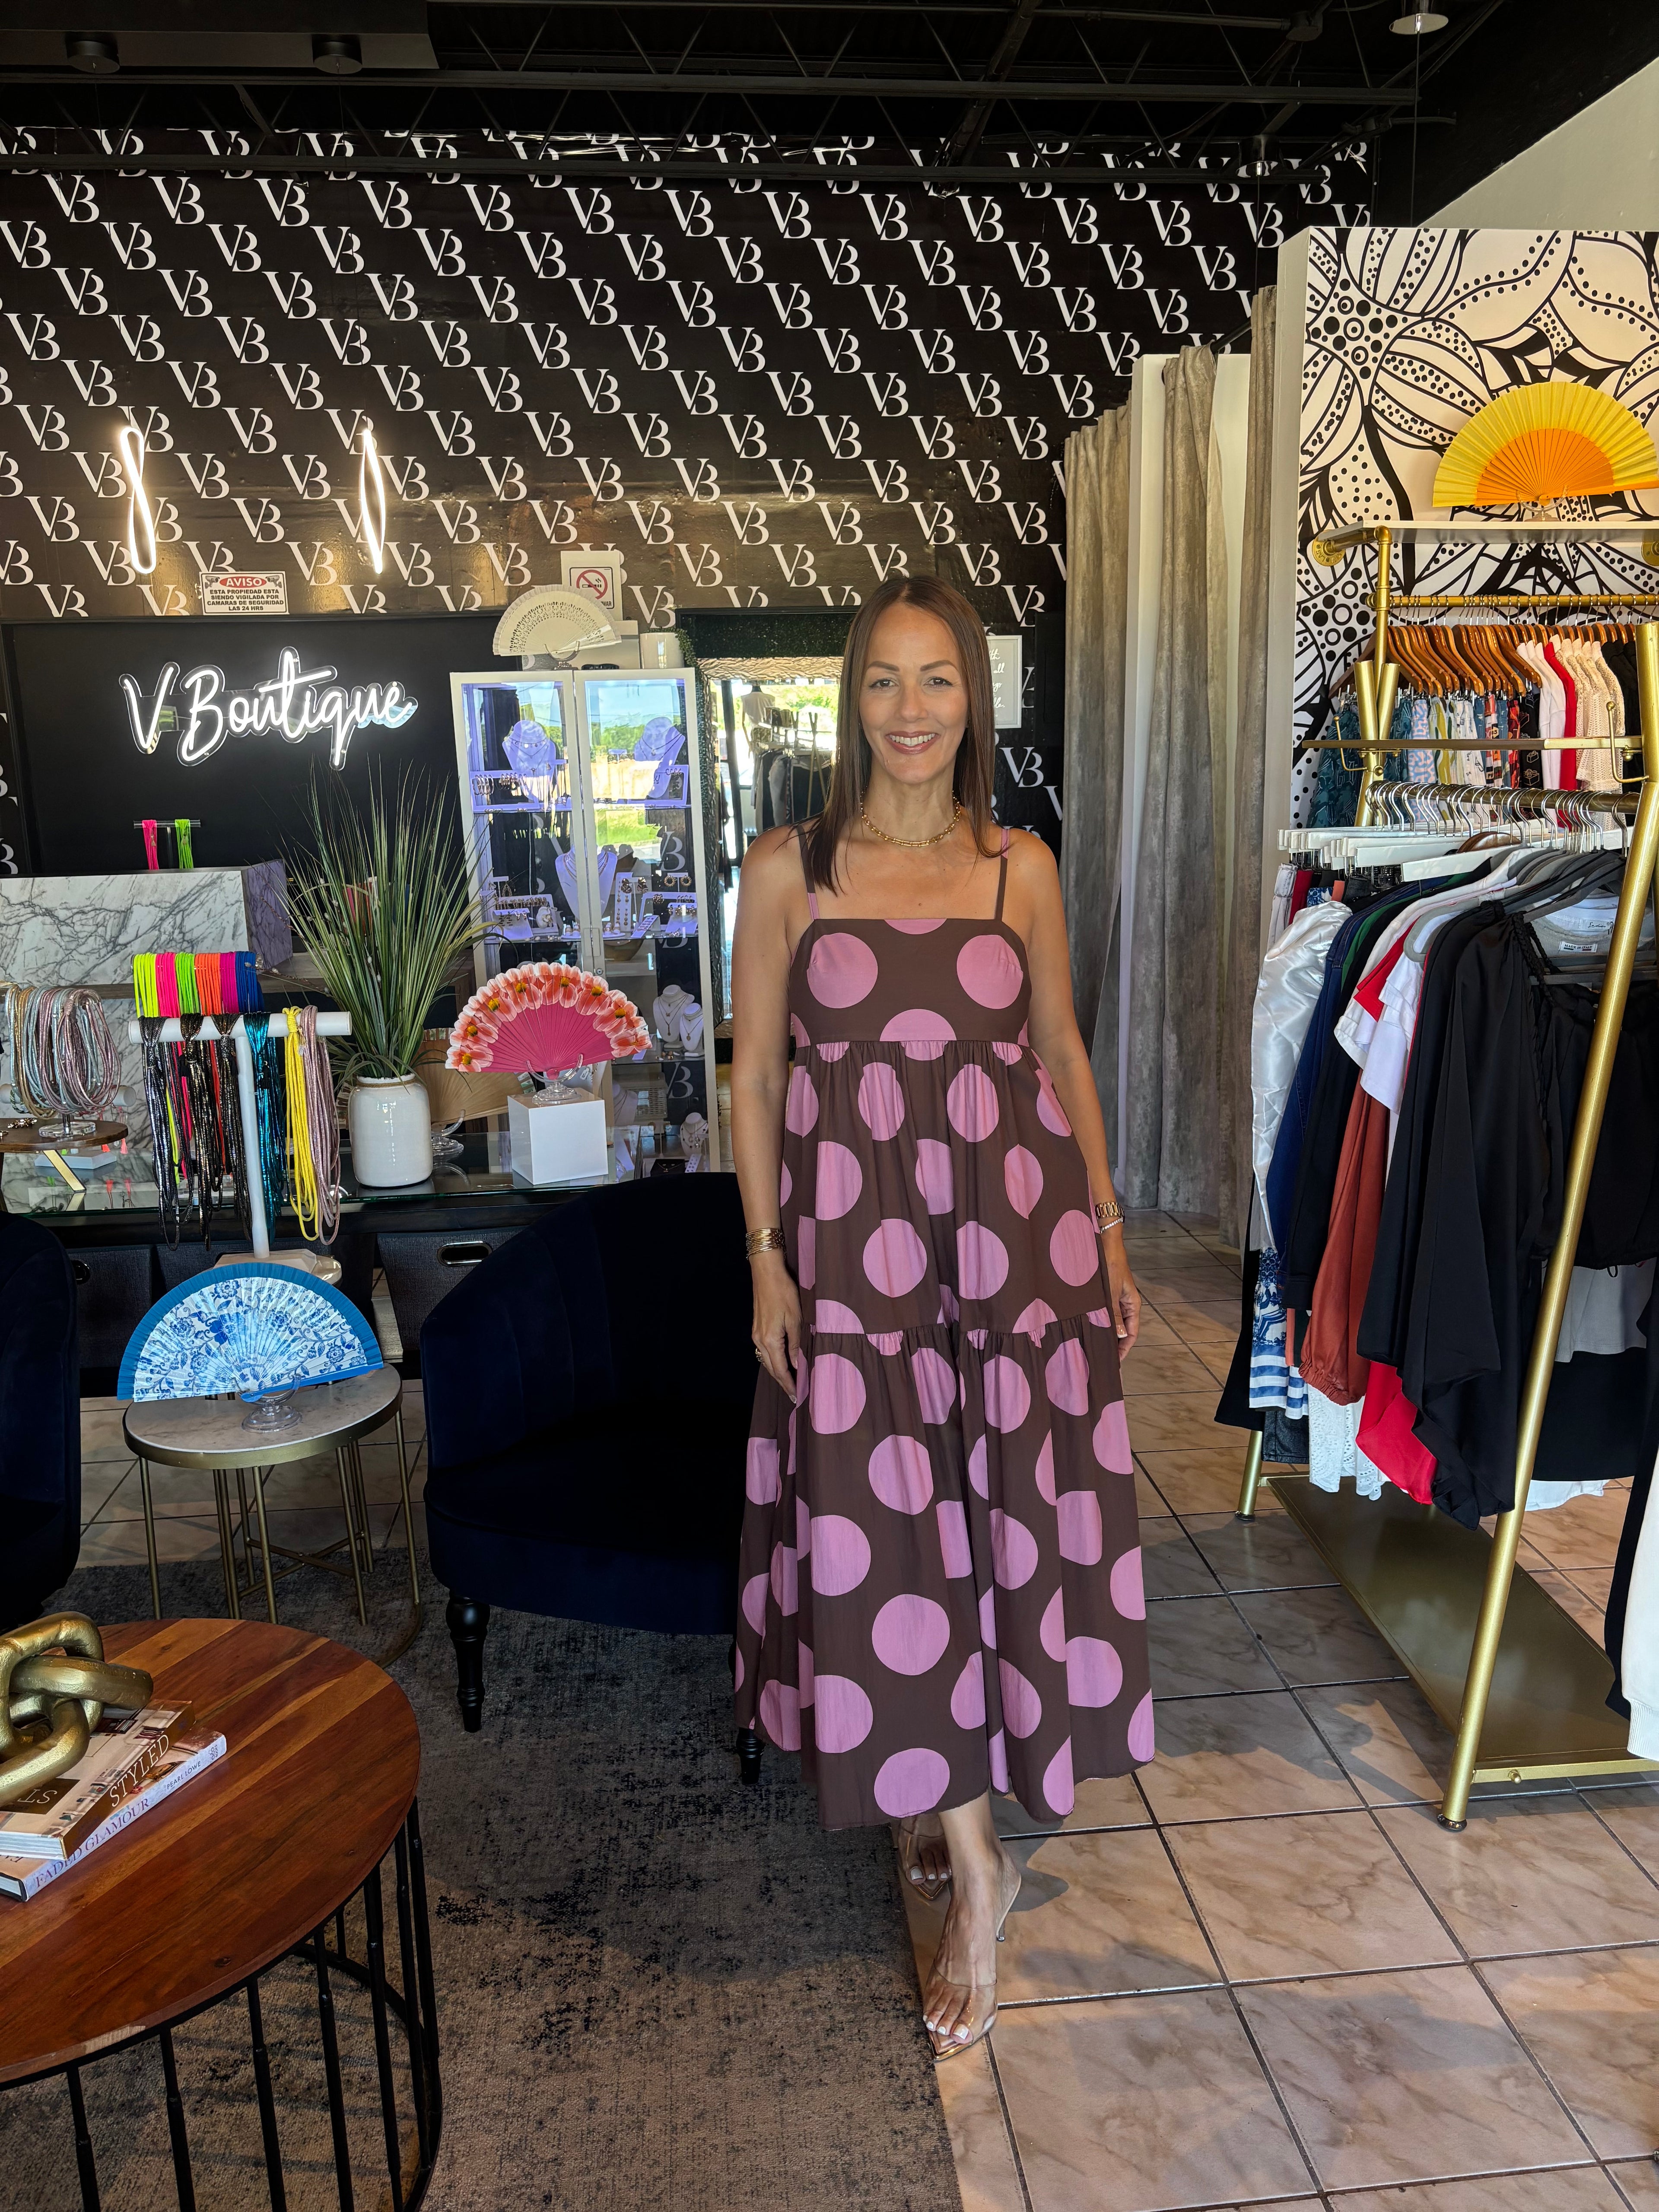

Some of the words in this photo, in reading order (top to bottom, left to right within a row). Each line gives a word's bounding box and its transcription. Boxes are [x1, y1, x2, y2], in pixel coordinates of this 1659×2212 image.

[42, 174, 99, 222] VB
[149, 176, 204, 224] VB
[254, 179, 309, 226] VB
[358, 180, 412, 228] VB
[461, 184, 514, 231] VB
[563, 188, 614, 234] VB
[663, 190, 713, 236] VB
[762, 192, 811, 238] VB
[859, 194, 908, 240] VB
[956, 196, 1004, 242] VB
[1052, 198, 1098, 244] VB
[1146, 200, 1192, 246] VB
[1239, 202, 1284, 248] VB
[0, 221, 51, 268] VB
[100, 222, 156, 270] VB
[206, 224, 261, 272] VB
[310, 226, 364, 273] VB
[412, 229, 465, 276] VB
[514, 232, 566, 278] VB
[615, 234, 665, 281] VB
[714, 237, 763, 283] VB
[811, 238, 860, 285] VB
[908, 240, 956, 286] VB
[1004, 242, 1051, 287] VB
[1097, 244, 1144, 289] VB
[1191, 246, 1236, 290] VB
[51, 268, 108, 315] VB
[157, 270, 212, 317] VB
[262, 272, 316, 318] VB
[365, 273, 418, 321] VB
[466, 276, 518, 323] VB
[566, 278, 617, 325] VB
[666, 281, 716, 327] VB
[763, 283, 812, 328] VB
[860, 284, 908, 330] VB
[955, 286, 1002, 331] VB
[1050, 287, 1096, 332] VB
[1143, 289, 1189, 334] VB
[3, 314, 60, 360] VB
[108, 315, 165, 362] VB
[214, 317, 269, 363] VB
[317, 318, 371, 365] VB
[418, 321, 470, 367] VB
[518, 323, 570, 369] VB
[618, 325, 668, 370] VB
[716, 327, 765, 372] VB
[813, 328, 861, 373] VB
[908, 329, 955, 373] VB
[1003, 331, 1049, 375] VB
[61, 360, 117, 406] VB
[165, 361, 220, 408] VB
[270, 363, 323, 409] VB
[371, 365, 423, 411] VB
[471, 367, 522, 412] VB
[570, 369, 620, 413] VB
[669, 370, 718, 415] VB
[765, 372, 814, 416] VB
[861, 373, 908, 416] VB
[955, 373, 1002, 417] VB
[1049, 375, 1094, 418] VB
[13, 405, 69, 451] VB
[222, 408, 276, 453] VB
[424, 411, 475, 456] VB
[523, 412, 573, 456] VB
[621, 413, 671, 457] VB
[718, 414, 767, 458] VB
[814, 416, 861, 459] VB
[908, 416, 955, 459] VB
[1002, 416, 1048, 459] VB
[70, 452, 126, 497] VB
[174, 453, 229, 499] VB
[281, 454, 331, 499] VB
[378, 456, 429, 500] VB
[476, 457, 527, 501] VB
[574, 458, 624, 501] VB
[671, 458, 720, 502] VB
[767, 459, 816, 503] VB
[861, 460, 909, 502] VB
[955, 460, 1001, 502] VB
[24, 496, 79, 541] VB
[231, 498, 284, 542] VB
[429, 500, 480, 543] VB
[528, 500, 577, 543] VB
[625, 501, 674, 544] VB
[721, 502, 769, 545] VB
[815, 502, 862, 545] VB
[909, 502, 955, 545] VB
[1002, 502, 1047, 544] VB
[80, 541, 136, 585] VB
[226, 578, 262, 586] AVISO
[285, 542, 337, 585] VB
[384, 542, 434, 586] VB
[481, 543, 531, 586] VB
[674, 544, 722, 586] VB
[769, 544, 816, 587] VB
[955, 544, 1001, 586] VB
[628, 586, 676, 628] VB
[124, 666, 174, 749] V
[181, 650, 413, 766] Boutique
[999, 747, 1043, 787] VB
[110, 1734, 168, 1807] STYLED
[167, 1774, 184, 1790] PEARL
[185, 1761, 201, 1776] LOWE
[35, 1847, 82, 1888] FADED
[85, 1799, 150, 1851] GLAMOUR
